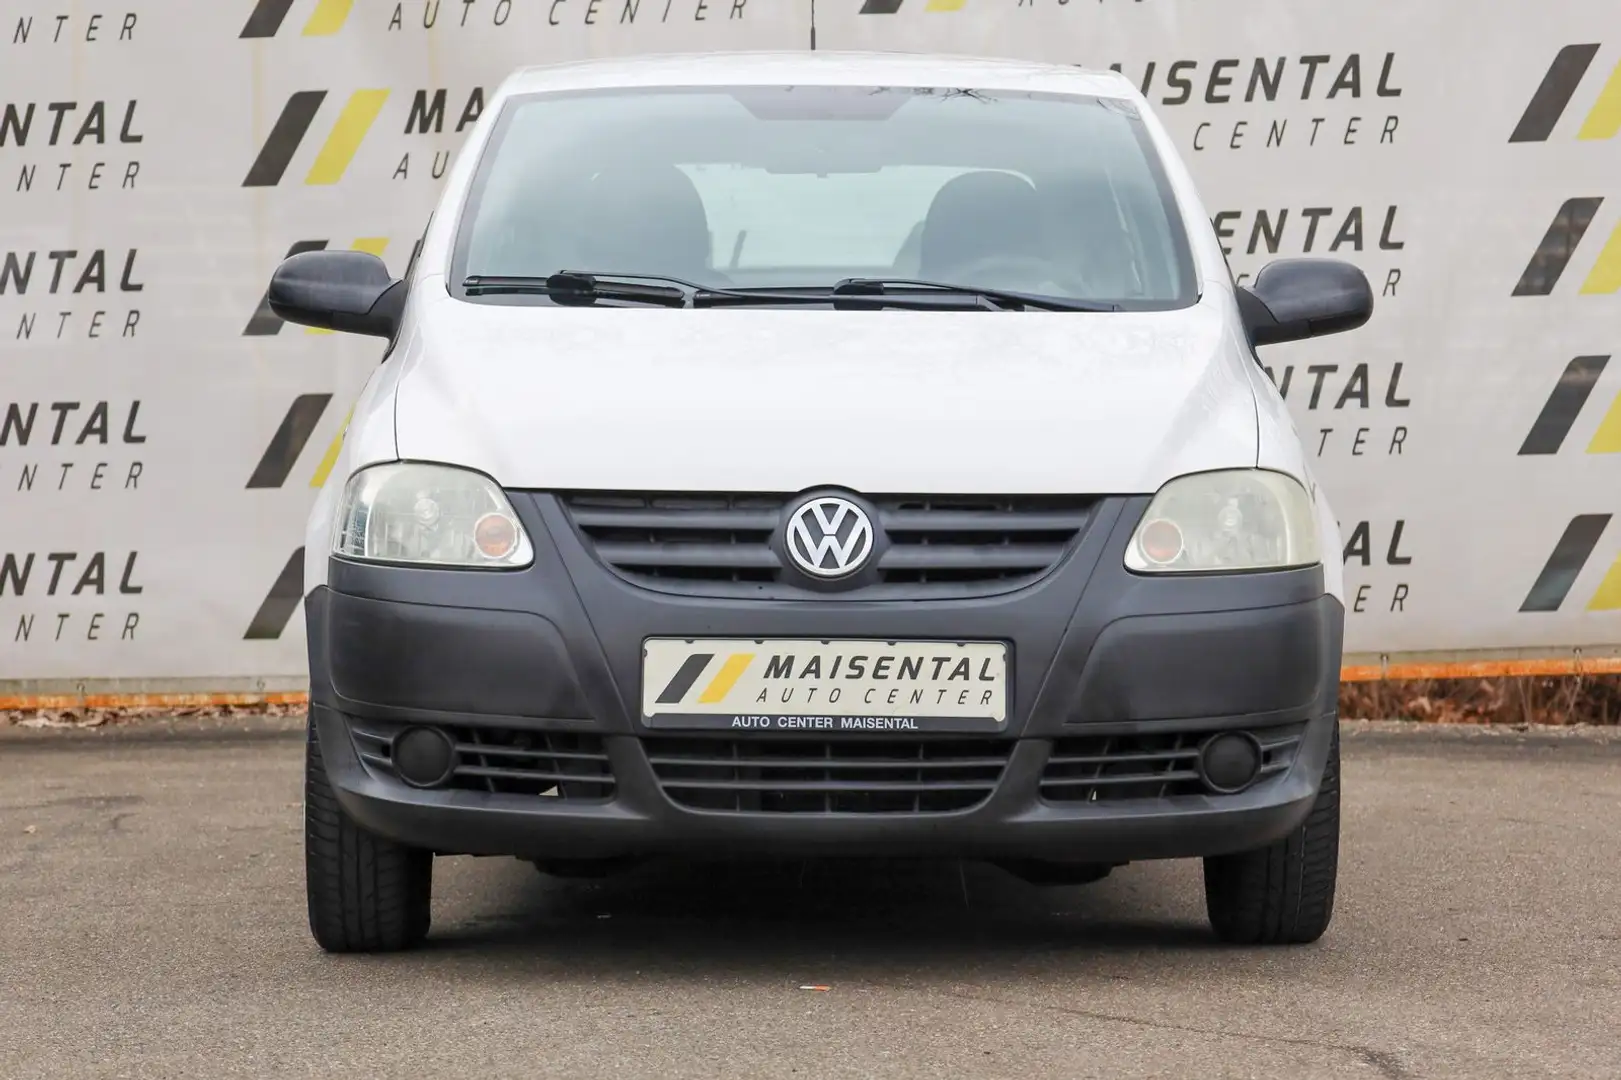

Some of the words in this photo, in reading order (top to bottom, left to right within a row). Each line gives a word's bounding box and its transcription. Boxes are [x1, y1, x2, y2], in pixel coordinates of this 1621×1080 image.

[388, 0, 512, 31] AUTO
[548, 0, 748, 25] CENTER
[1108, 52, 1402, 105] ISENTAL
[404, 86, 484, 134] MA
[1193, 115, 1399, 151] CENTER
[0, 400, 147, 447] NTAL
[1337, 519, 1412, 566] AL
[763, 654, 996, 682] MAISENTAL
[756, 687, 842, 704] AUTO
[863, 688, 994, 706] CENTER
[731, 716, 771, 729] AUTO
[777, 717, 834, 730] CENTER
[840, 718, 919, 731] MAISENTAL
